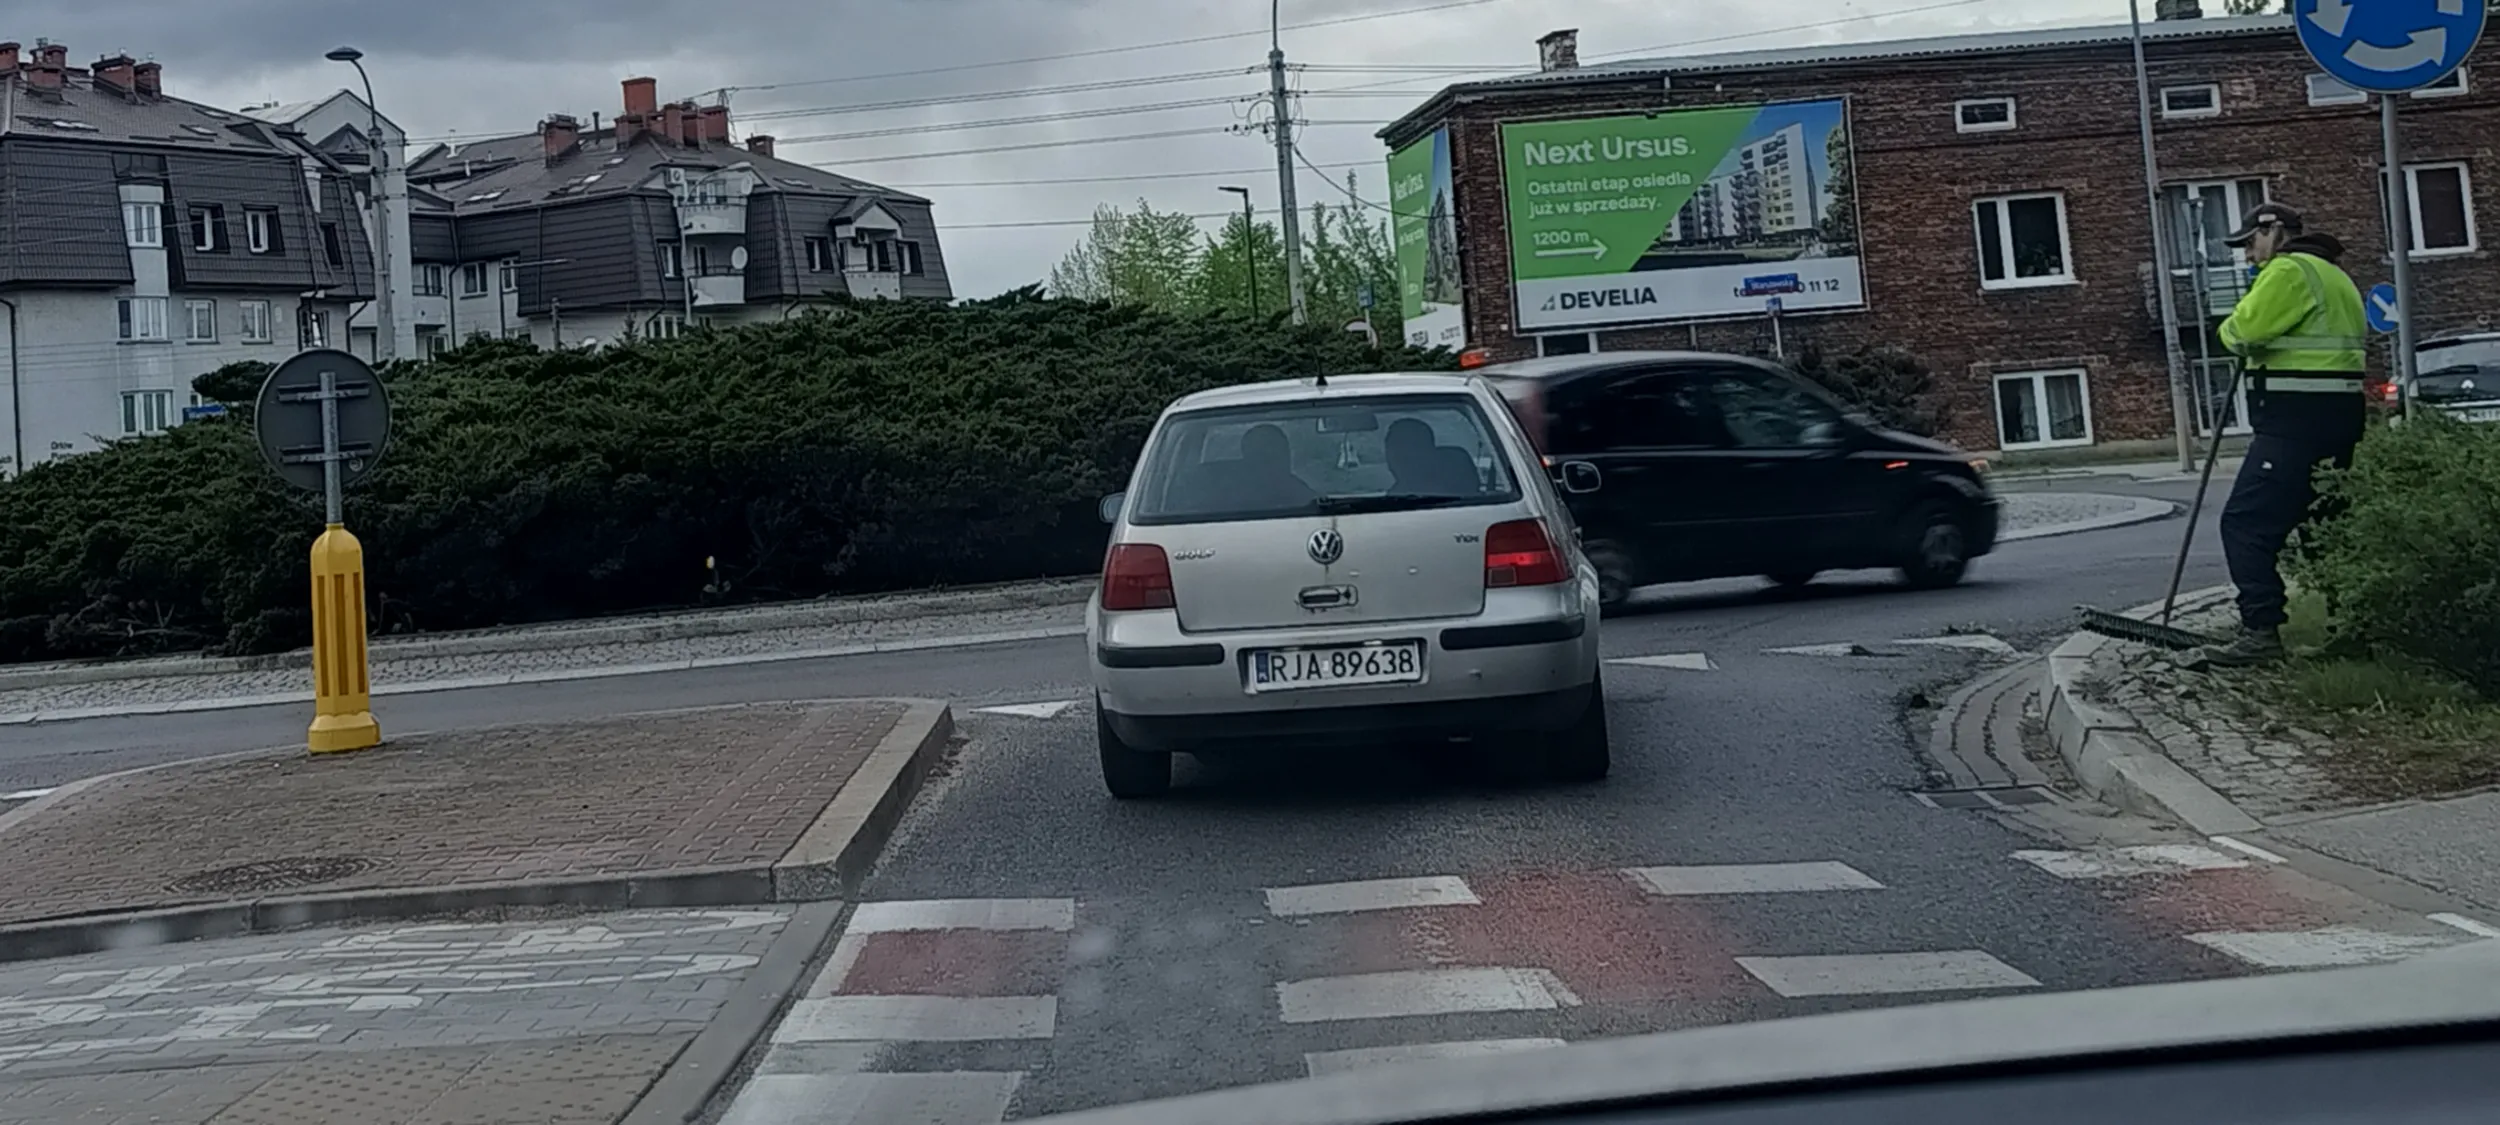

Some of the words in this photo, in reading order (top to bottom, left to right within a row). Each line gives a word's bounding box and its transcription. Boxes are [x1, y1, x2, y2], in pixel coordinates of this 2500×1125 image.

[1524, 139, 1596, 166] Next
[1601, 135, 1697, 161] Ursus.
[1528, 177, 1588, 195] Ostatni
[1591, 177, 1629, 192] etap
[1632, 171, 1692, 188] osiedla
[1528, 201, 1554, 219] już
[1555, 202, 1570, 213] w
[1574, 194, 1663, 215] sprzedaży.
[1533, 231, 1571, 245] 1200
[1574, 232, 1590, 243] m
[1809, 280, 1821, 292] 11
[1824, 279, 1840, 291] 12
[1560, 287, 1657, 310] DEVELIA
[1270, 652, 1322, 682] RJA
[1331, 648, 1414, 678] 89638
